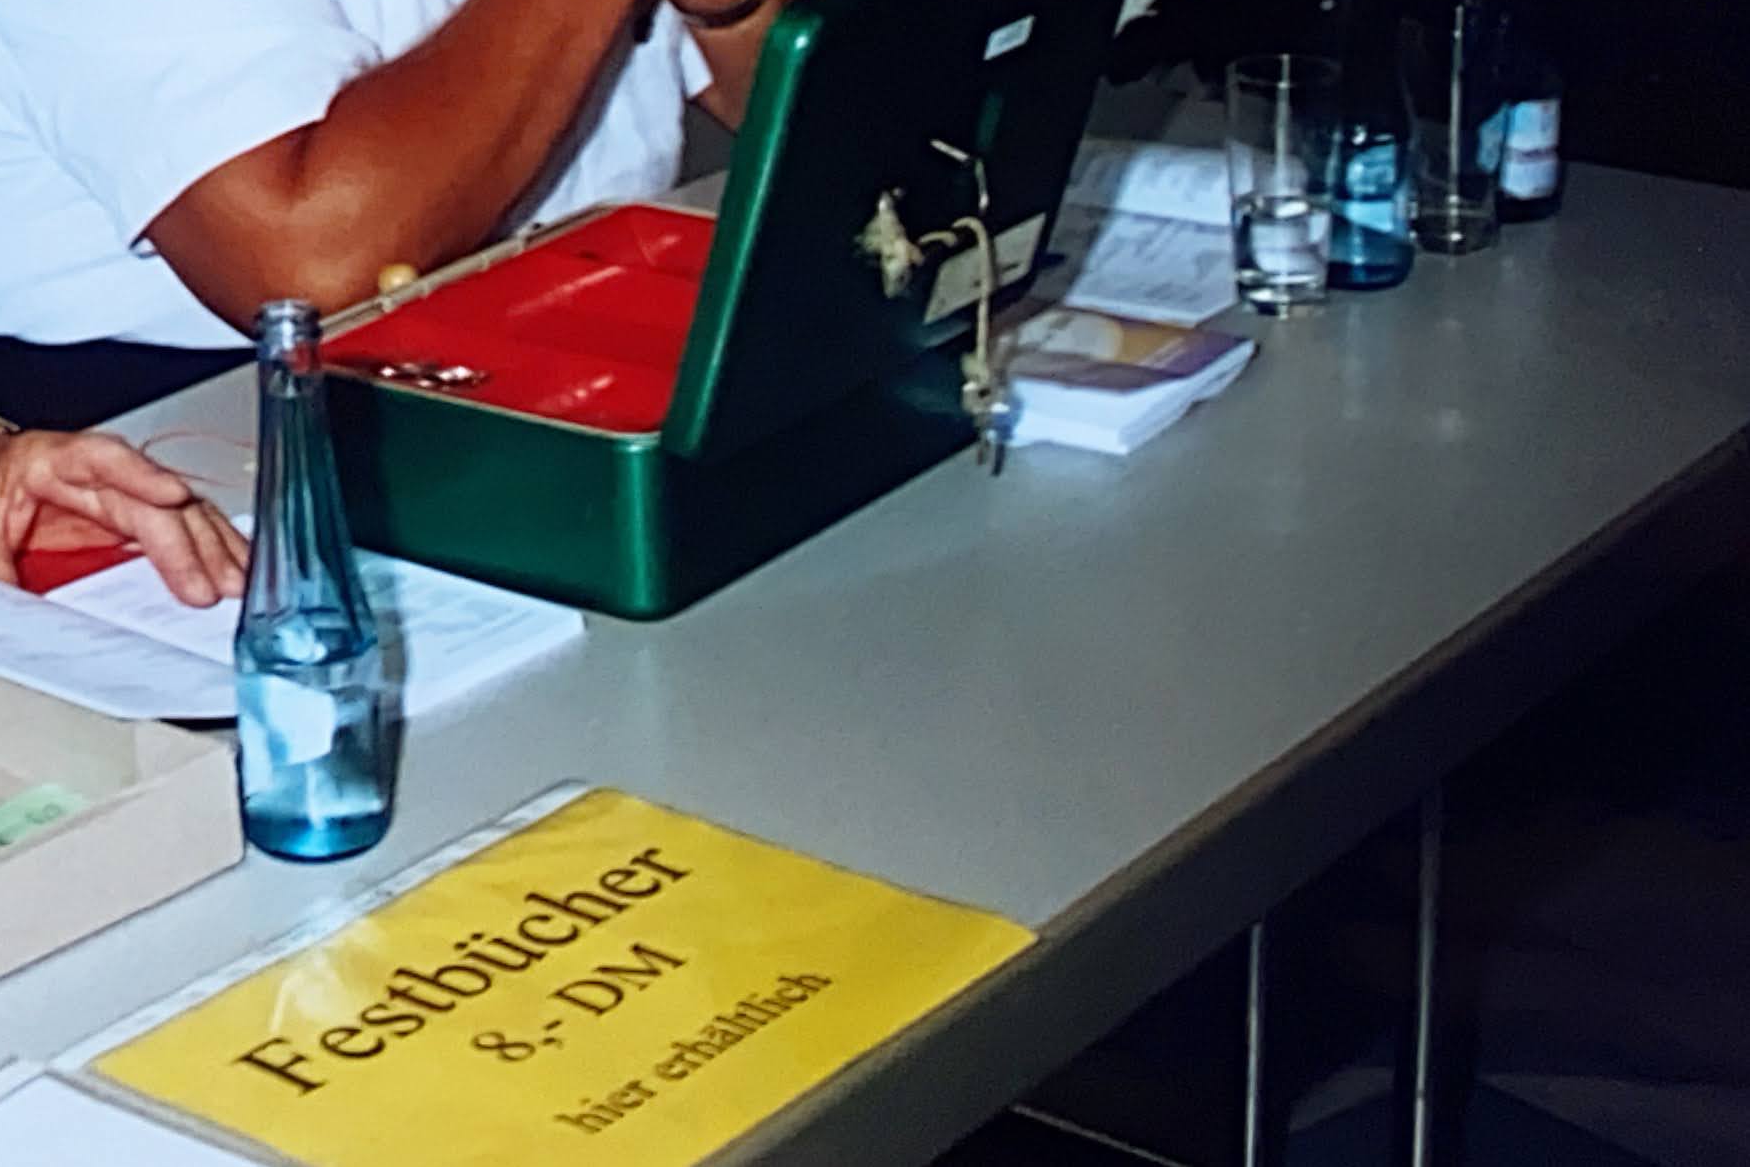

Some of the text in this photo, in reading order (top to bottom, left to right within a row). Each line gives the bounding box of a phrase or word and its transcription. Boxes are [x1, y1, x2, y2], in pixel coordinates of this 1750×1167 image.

[234, 847, 690, 1096] Festbücher
[548, 942, 688, 1017] DM
[553, 971, 835, 1135] hier erhältlich
